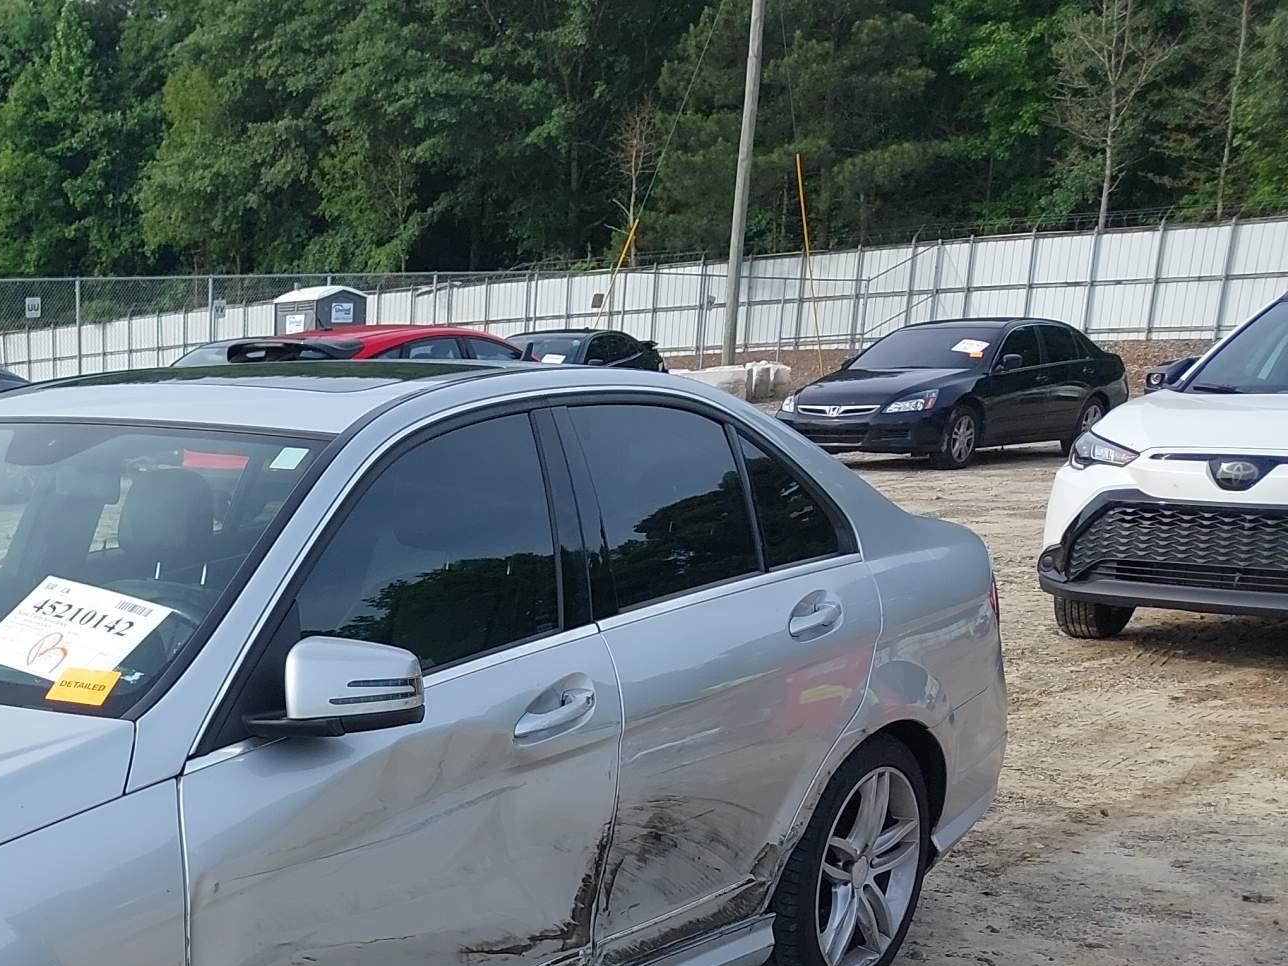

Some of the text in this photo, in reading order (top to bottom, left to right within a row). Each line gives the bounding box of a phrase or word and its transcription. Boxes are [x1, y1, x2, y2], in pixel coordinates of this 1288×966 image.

[27, 303, 40, 312] UU
[32, 598, 134, 636] 45210142
[59, 679, 106, 692] DETAILED
